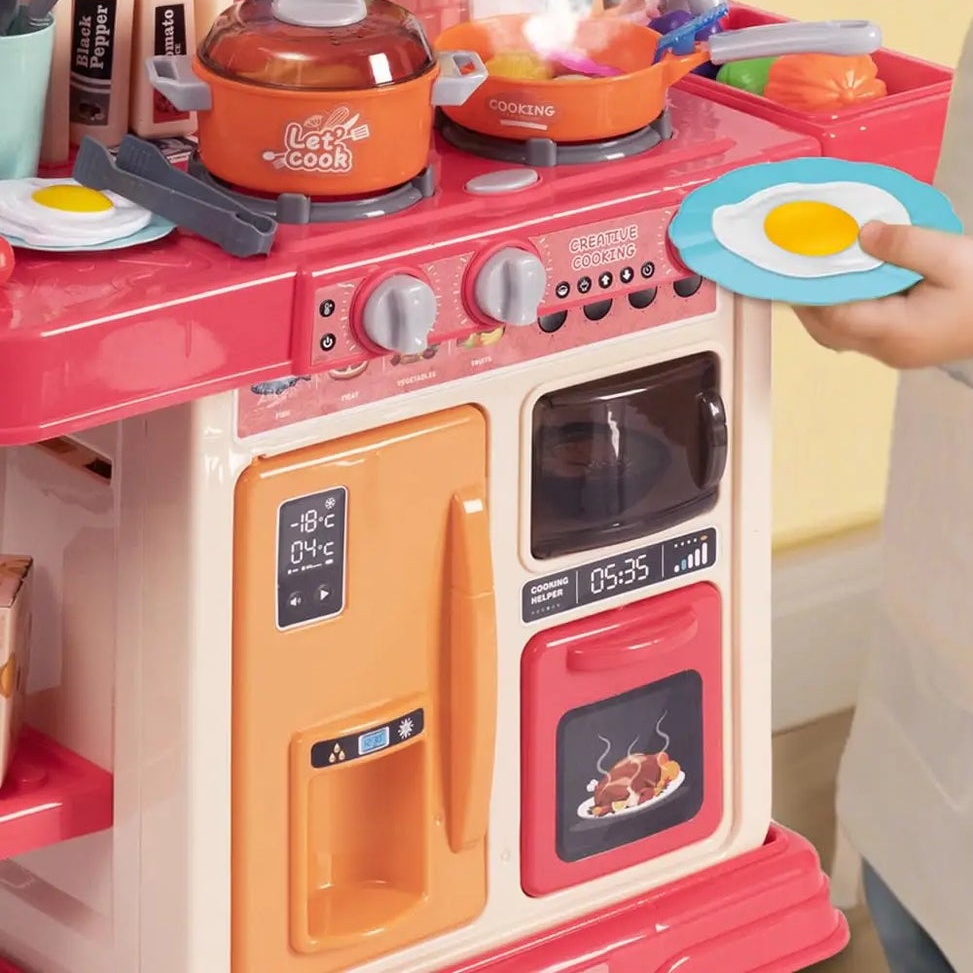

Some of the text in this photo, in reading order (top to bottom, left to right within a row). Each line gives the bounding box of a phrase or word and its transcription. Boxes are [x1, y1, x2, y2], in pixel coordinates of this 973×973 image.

[76, 15, 92, 68] Black
[90, 4, 111, 69] Pepper
[162, 9, 174, 56] omato
[489, 99, 556, 116] COOKING
[569, 226, 638, 253] CREATIVE
[572, 243, 637, 270] COOKING
[530, 576, 569, 595] COOKING
[590, 554, 649, 594] 05:35
[530, 588, 564, 605] HELPER
